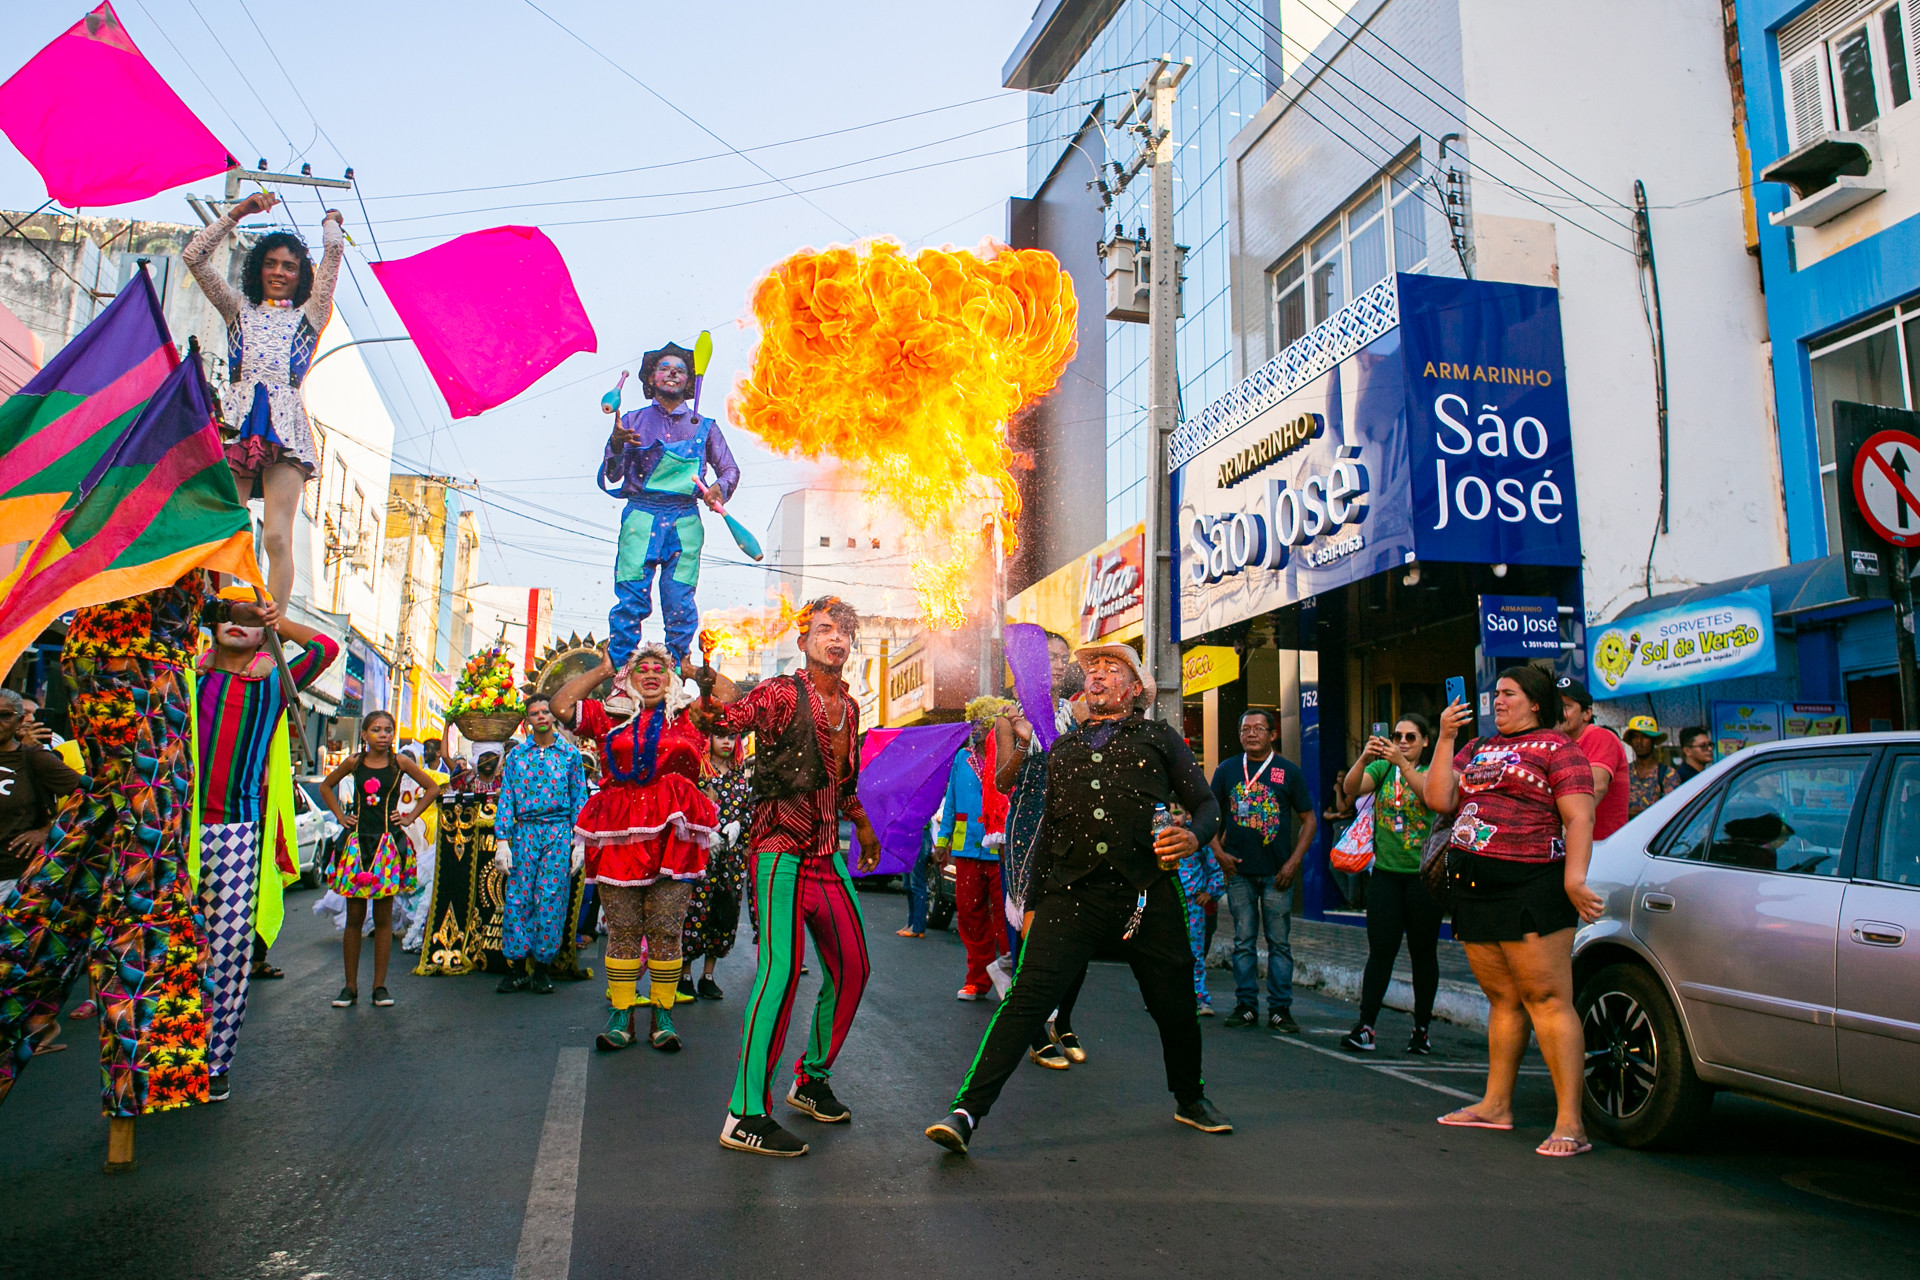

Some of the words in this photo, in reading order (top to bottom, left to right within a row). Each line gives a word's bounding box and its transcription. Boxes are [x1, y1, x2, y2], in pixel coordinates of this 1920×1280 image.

[1423, 361, 1552, 387] ARMARINHO
[1434, 393, 1549, 459] São
[1217, 412, 1314, 488] ARMARINHO
[1433, 459, 1563, 530] José
[1190, 512, 1256, 585] São
[1263, 444, 1357, 570] José
[1316, 536, 1363, 564] 3511-0763
[1500, 605, 1543, 613] ARMARINHO
[1487, 613, 1518, 632] São
[1523, 614, 1557, 634] José
[1660, 612, 1733, 637] SORVETES
[1640, 639, 1668, 666] Sol
[1674, 638, 1694, 658] de
[1698, 624, 1759, 654] Verão
[1301, 690, 1318, 708] 752
